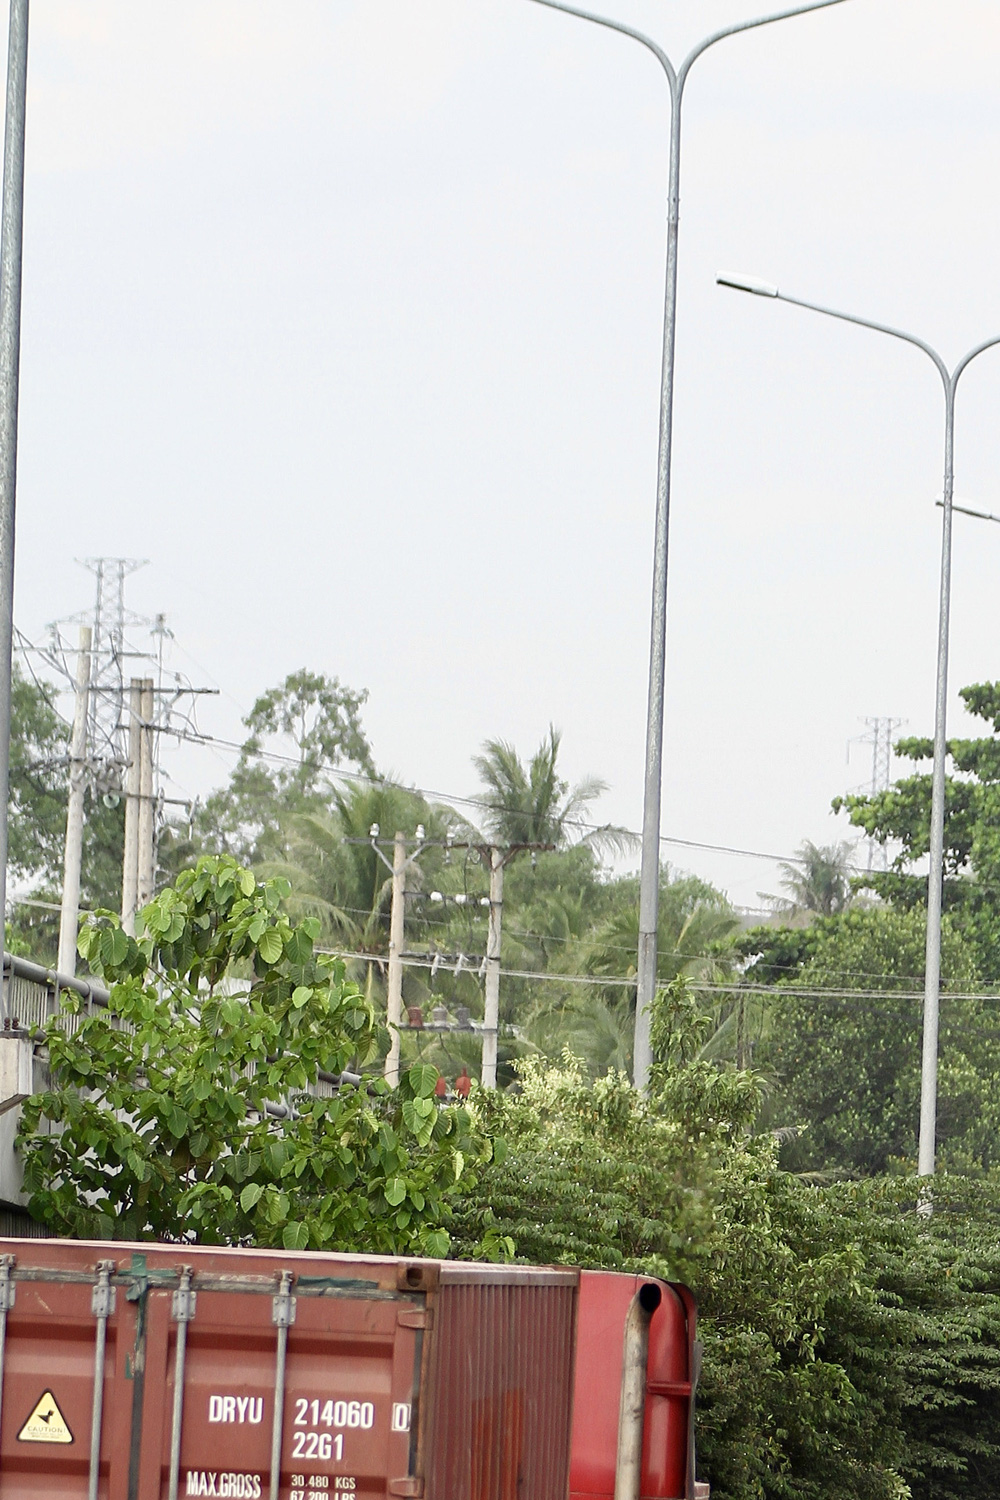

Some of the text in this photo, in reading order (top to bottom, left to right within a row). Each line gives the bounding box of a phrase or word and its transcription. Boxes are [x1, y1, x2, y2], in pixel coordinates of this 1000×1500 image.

[208, 1395, 411, 1430] DRYU 214060 0
[291, 1431, 344, 1461] 22G1
[186, 1470, 357, 1499] MAX.GROSS 30.480 KGS
